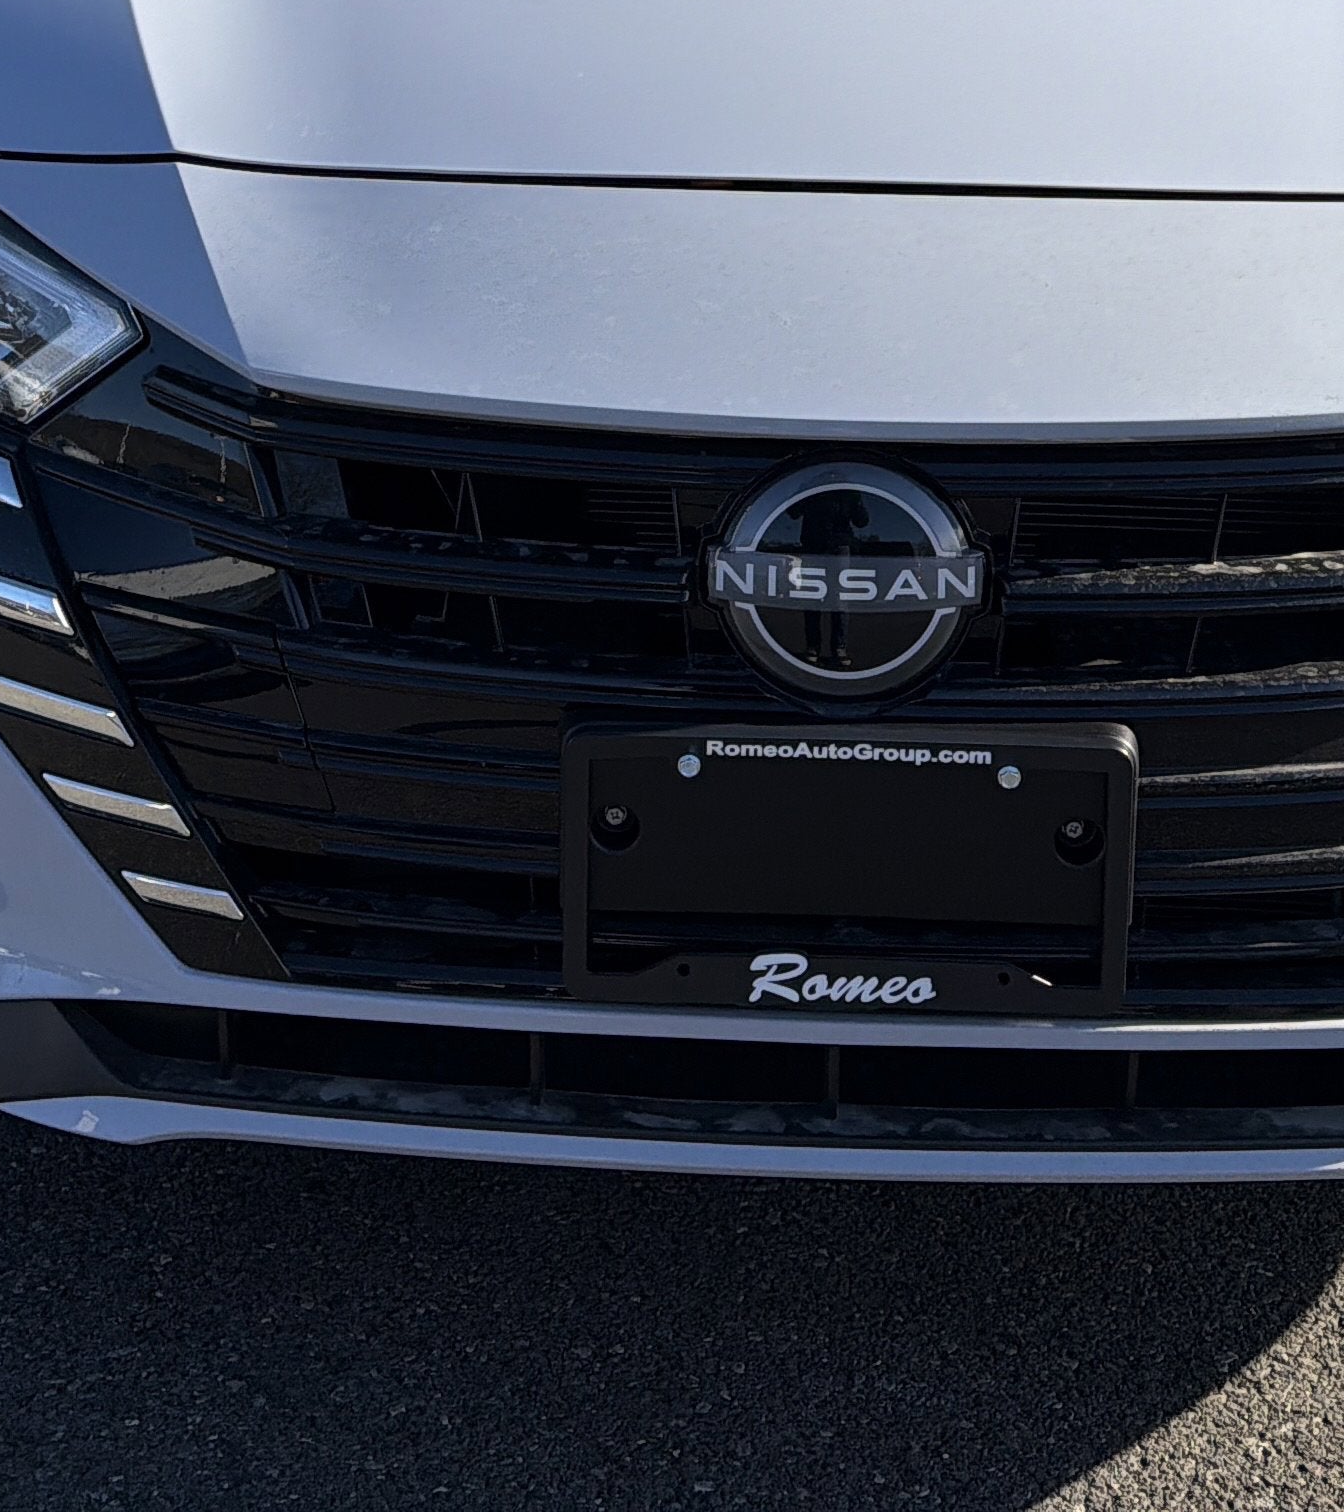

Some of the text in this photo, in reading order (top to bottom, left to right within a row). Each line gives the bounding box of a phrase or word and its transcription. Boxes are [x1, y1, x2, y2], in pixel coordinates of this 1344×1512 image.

[715, 559, 976, 601] NISSAN
[706, 740, 992, 766] RomeoAutoGroup.com
[749, 953, 937, 1004] Romeo
